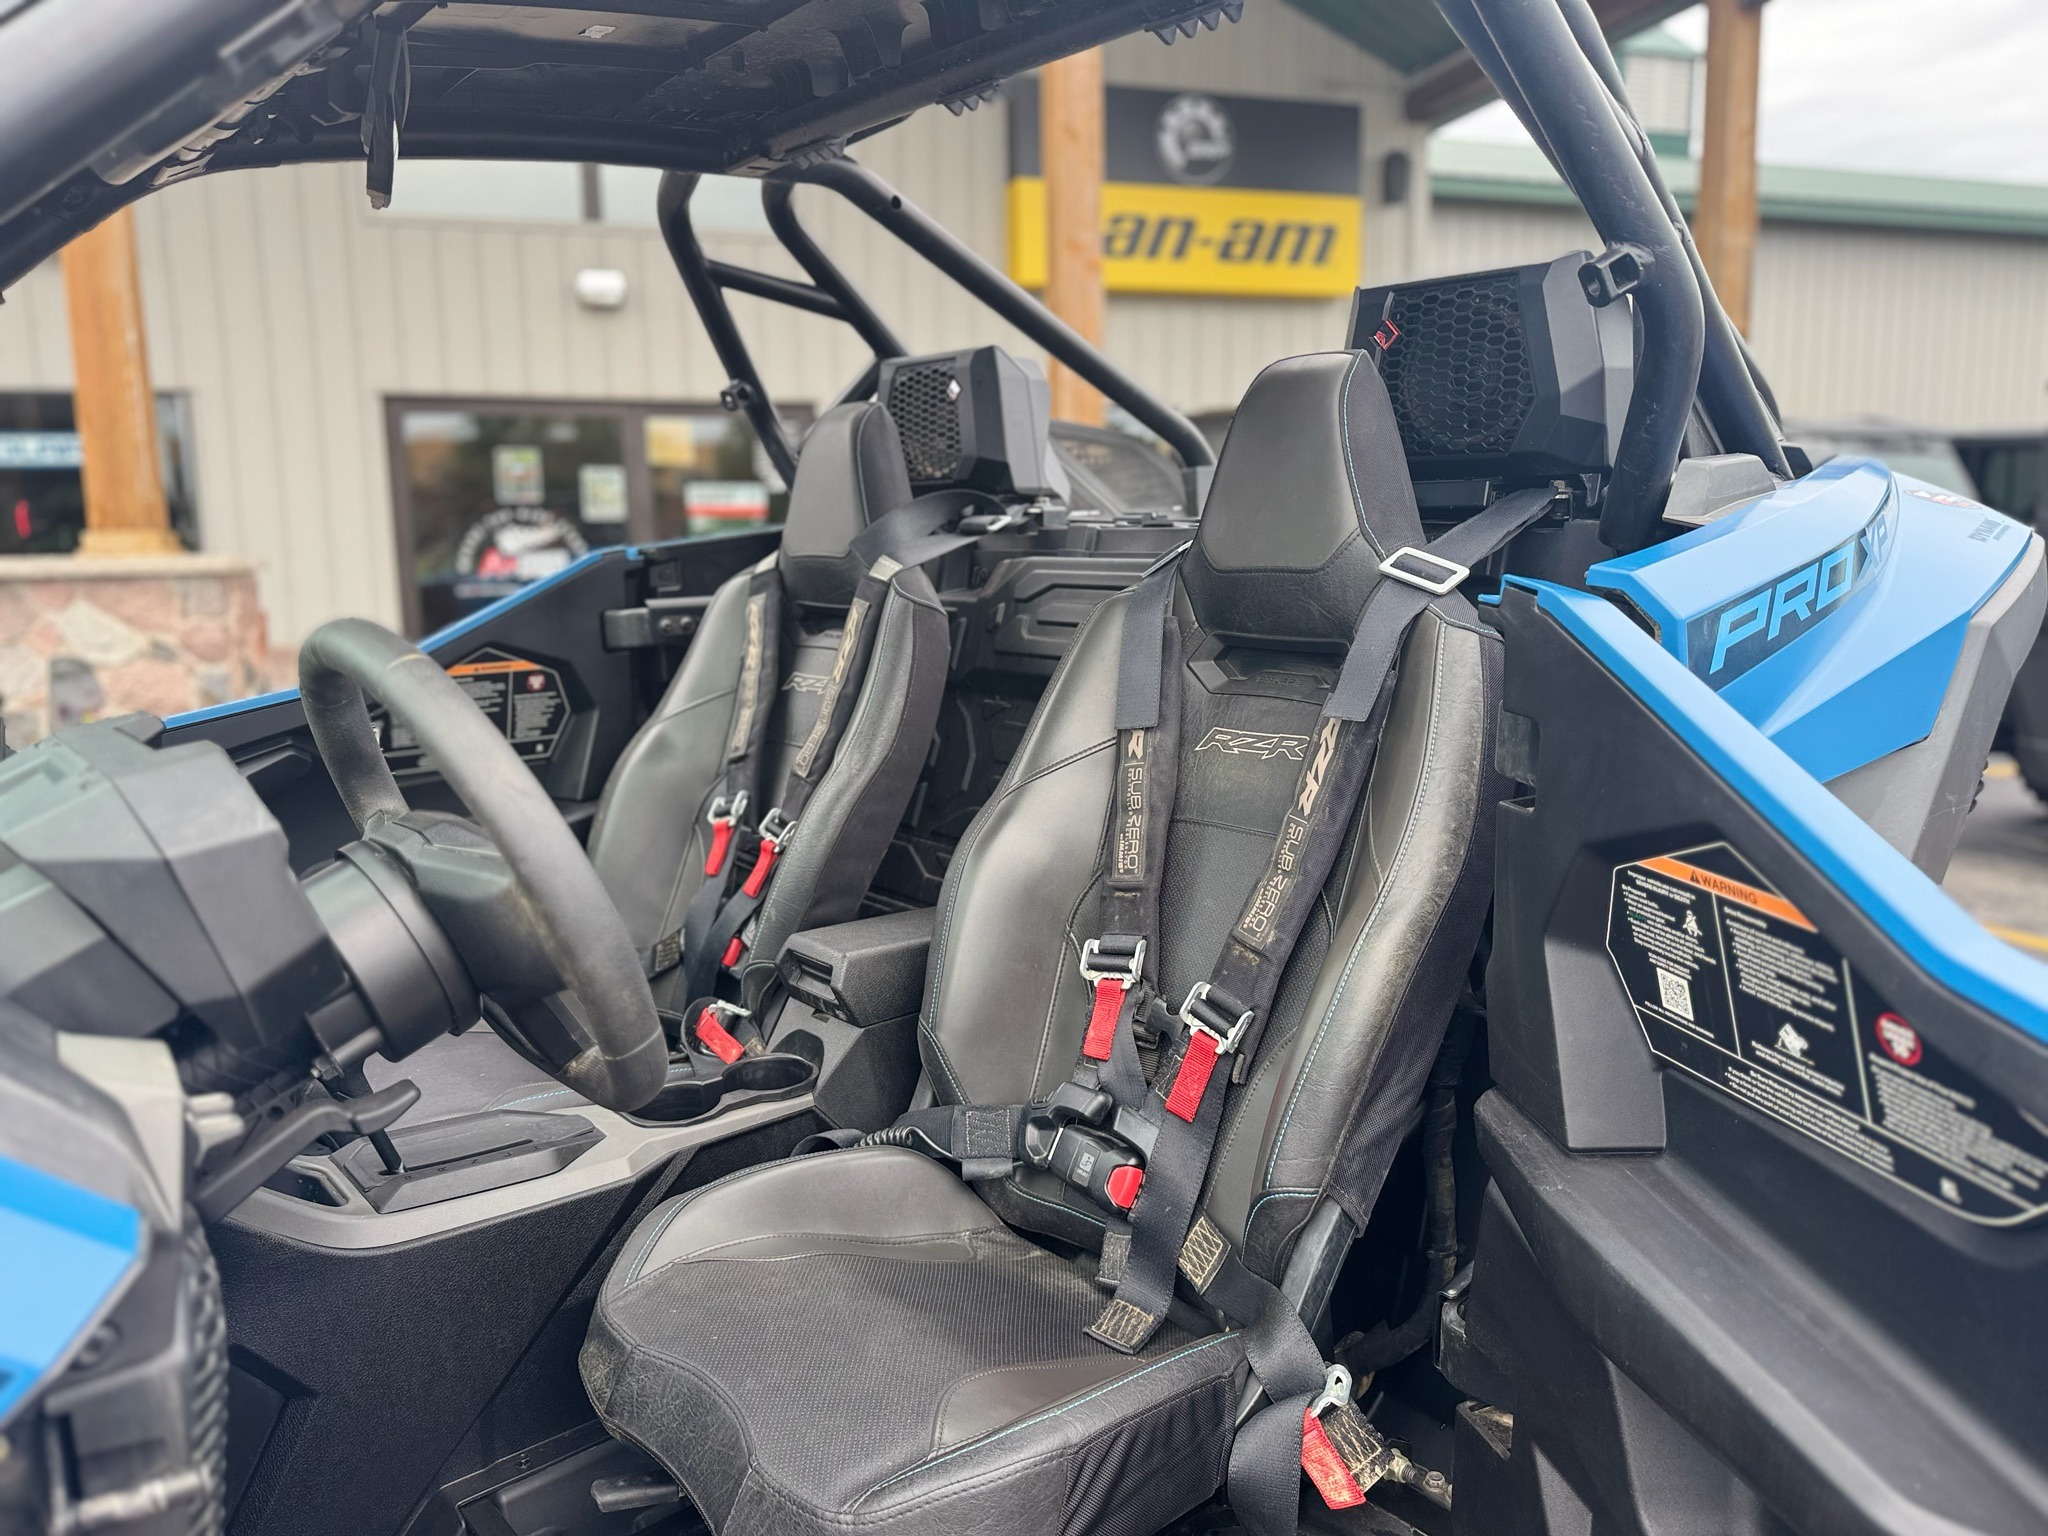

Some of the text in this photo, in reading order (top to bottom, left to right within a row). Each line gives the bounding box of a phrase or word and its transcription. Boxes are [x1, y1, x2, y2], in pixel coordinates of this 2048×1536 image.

[1102, 212, 1338, 266] an-am
[1710, 540, 1855, 675] PRO
[781, 671, 833, 696] RZ
[1194, 727, 1311, 761] RZR
[1131, 768, 1143, 809] SUB
[1298, 718, 1342, 817] RZR
[1281, 825, 1304, 872] SUB
[1700, 874, 1758, 905] WARNING
